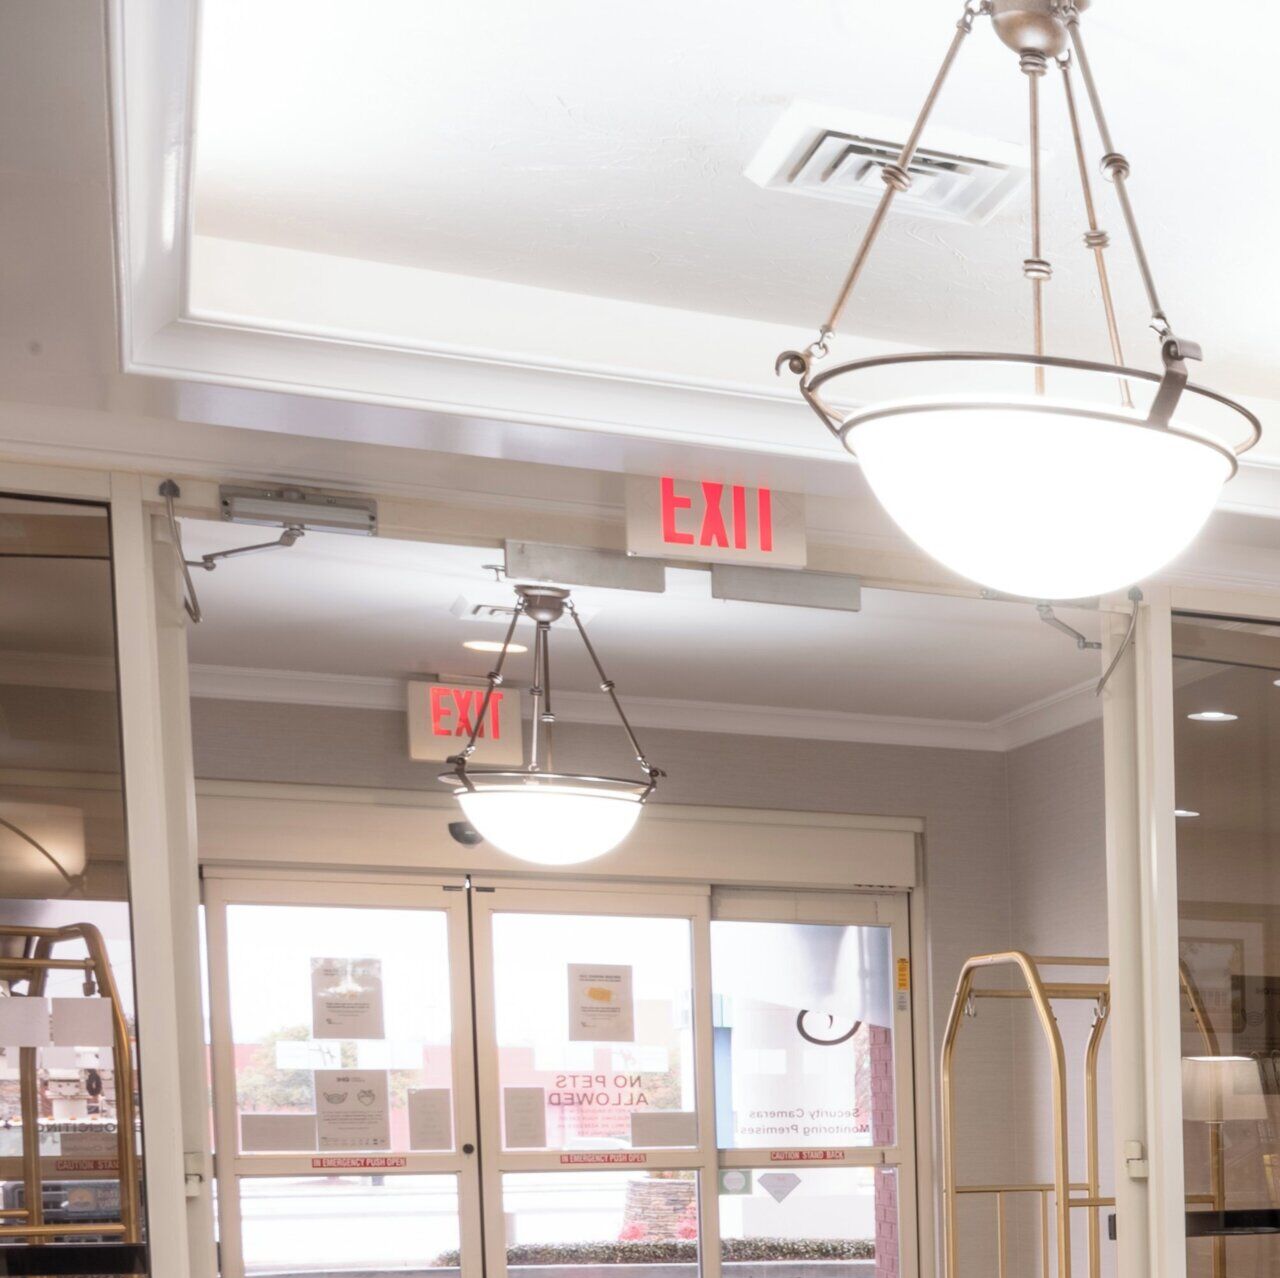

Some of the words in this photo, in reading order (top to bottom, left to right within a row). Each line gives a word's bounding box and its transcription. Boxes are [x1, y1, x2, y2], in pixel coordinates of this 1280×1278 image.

[430, 686, 504, 740] EXIT
[771, 1151, 800, 1160] CAUTION
[802, 1151, 823, 1160] STAND
[826, 1150, 844, 1159] BACK
[57, 1161, 95, 1171] CAUTION
[98, 1160, 119, 1170] STAN
